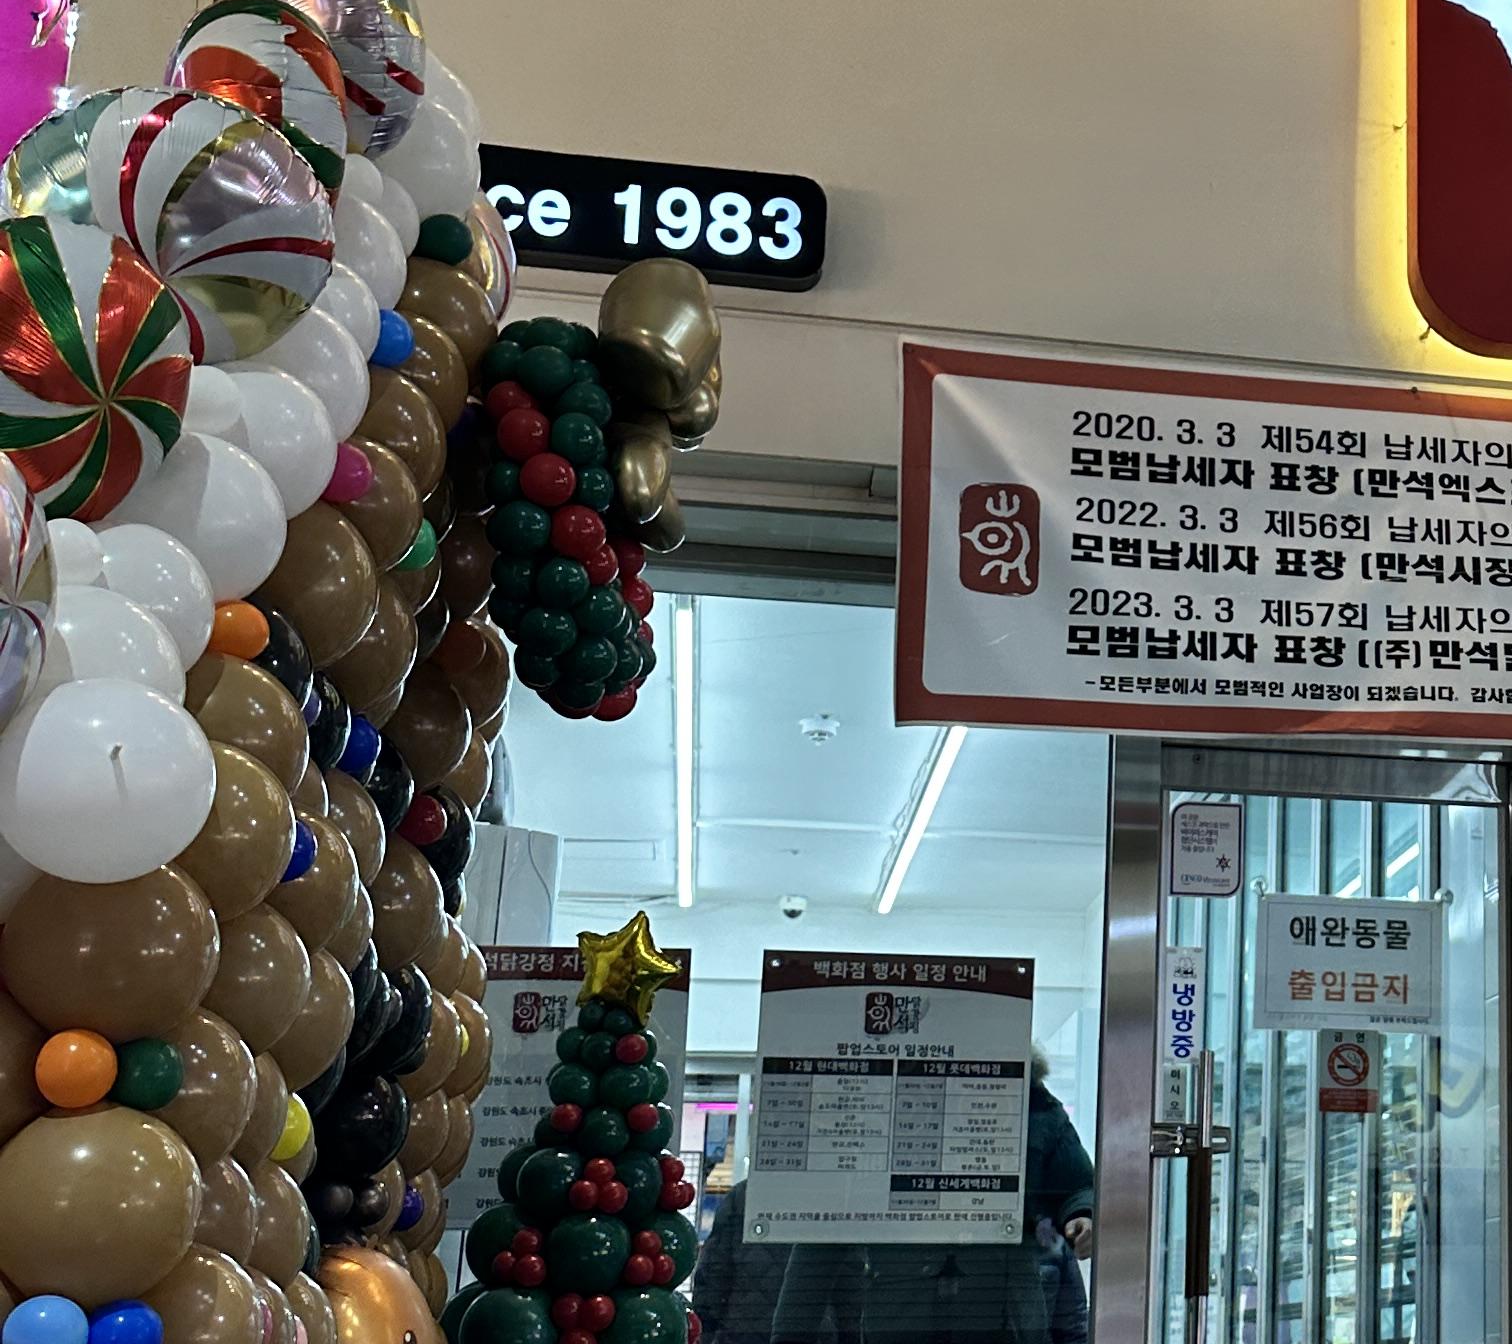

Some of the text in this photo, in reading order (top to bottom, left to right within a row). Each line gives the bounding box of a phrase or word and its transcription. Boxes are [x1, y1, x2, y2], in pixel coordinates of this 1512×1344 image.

[614, 184, 802, 260] 1983
[1072, 411, 1164, 442] 2020.
[1216, 422, 1236, 447] 3
[1261, 425, 1367, 458] 제54회
[1384, 433, 1512, 469] 납세자의
[1070, 447, 1255, 489] 모범납세자
[1269, 462, 1340, 495] 표창
[1075, 497, 1166, 527] 2022.
[1219, 507, 1239, 533] 3
[1264, 510, 1370, 542] 제56회
[1071, 532, 1259, 575] 모범납세자
[1275, 548, 1347, 580] 표창
[1068, 588, 1161, 618] 2023.
[1214, 597, 1234, 623] 3
[1260, 599, 1368, 630] 제57회
[1066, 625, 1258, 664] 모범납세자
[1274, 635, 1346, 667] 표창
[1215, 679, 1284, 698] 모범적인
[1291, 683, 1359, 702] 사업장이
[1289, 916, 1412, 950] 애완동물
[485, 953, 555, 972] 석닭강정
[813, 961, 987, 982] 백화점 행사 일정 안내
[1288, 971, 1409, 1005] 출입금지
[1171, 983, 1196, 1059] 냉방중
[837, 1043, 899, 1056] 팝업스토어
